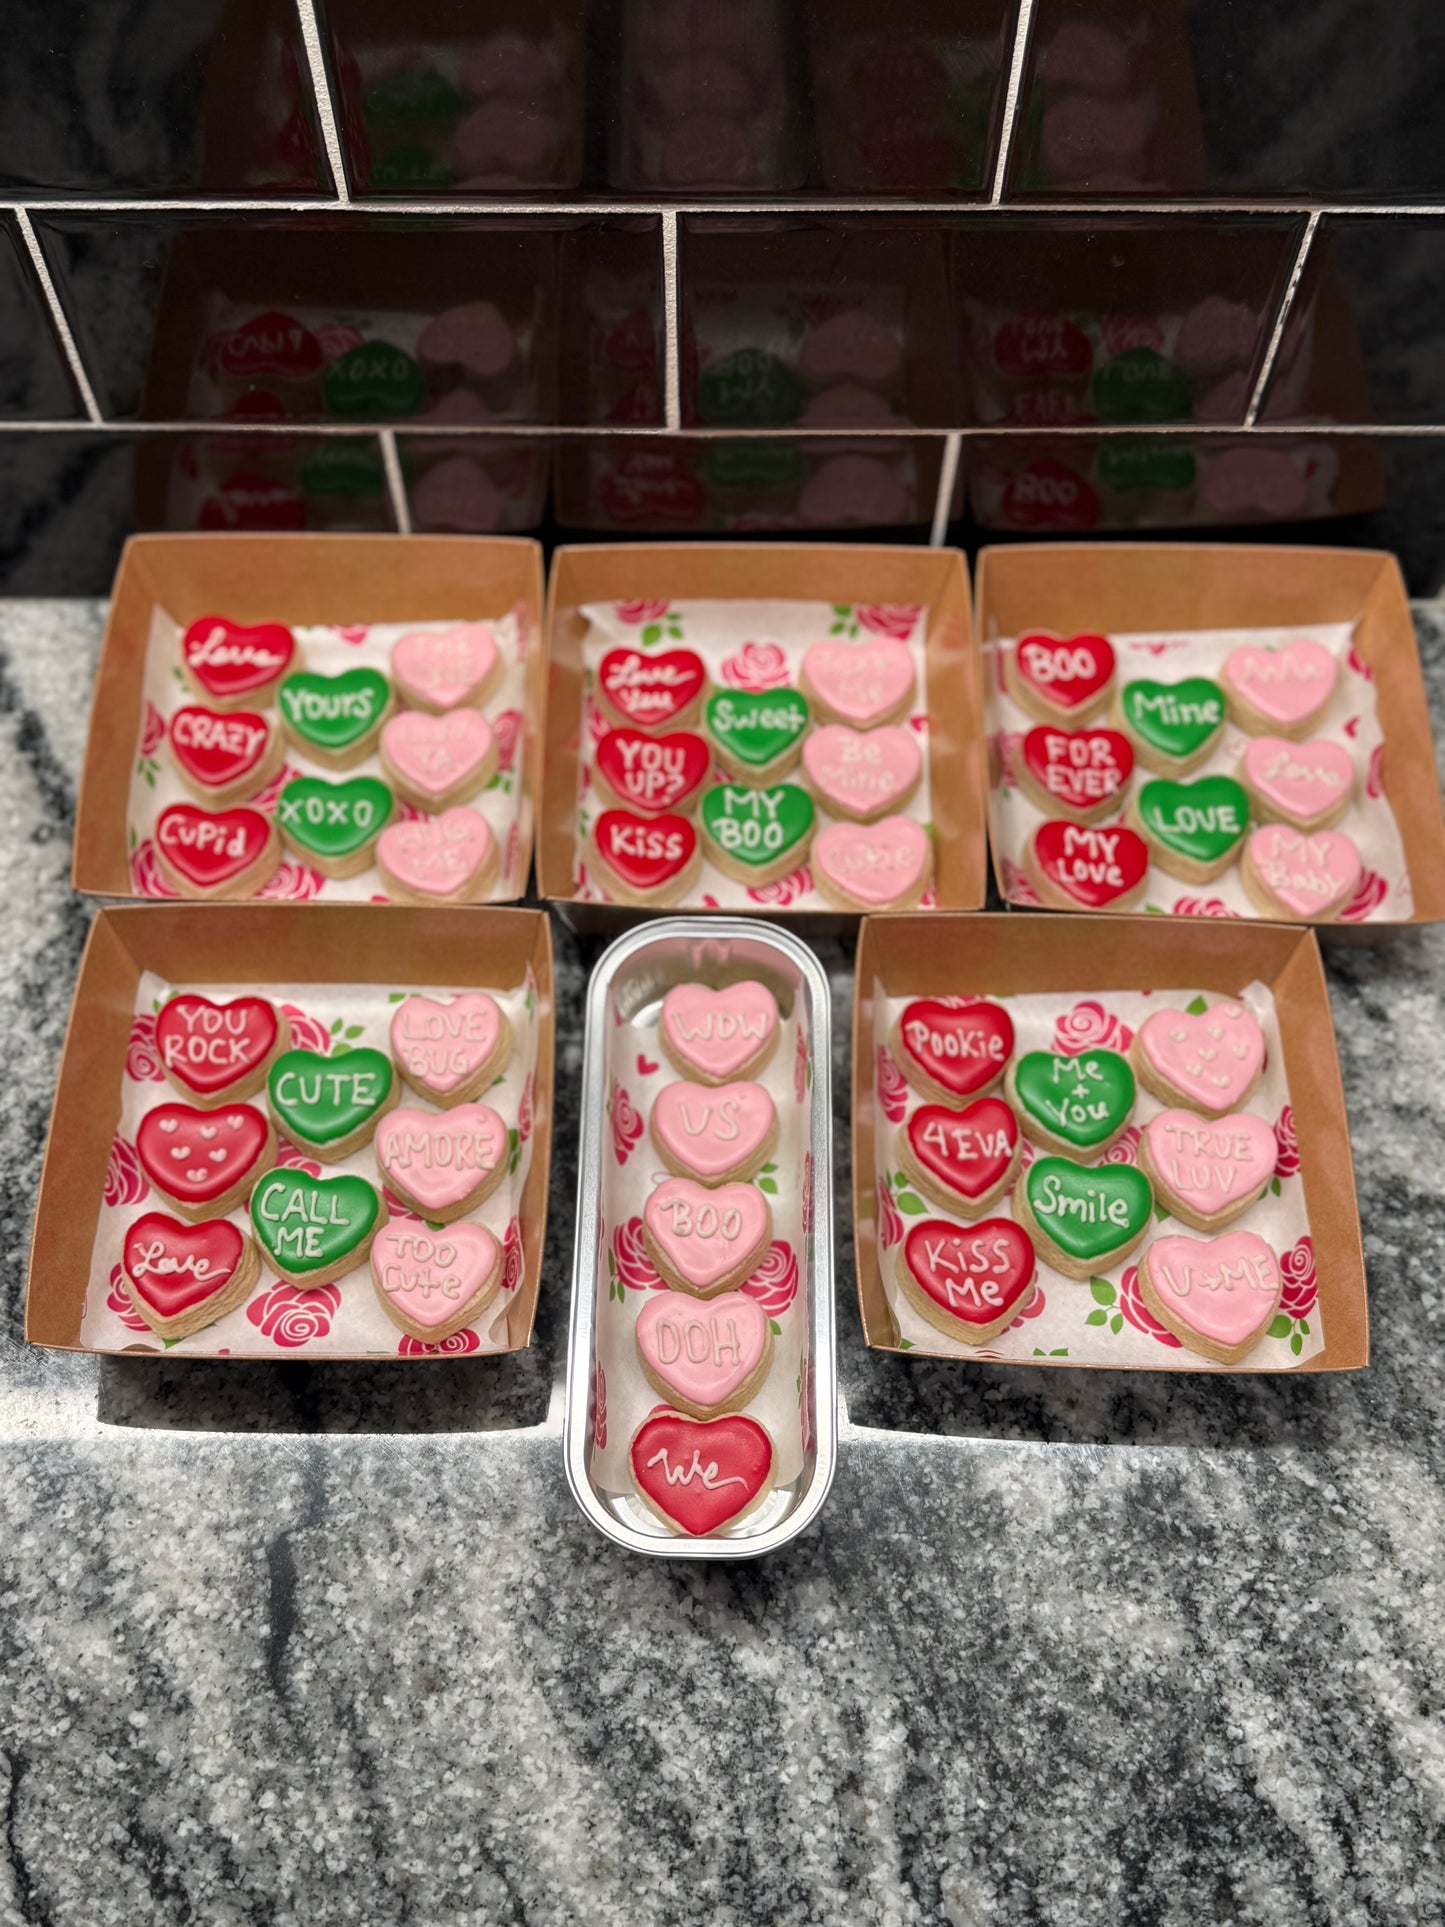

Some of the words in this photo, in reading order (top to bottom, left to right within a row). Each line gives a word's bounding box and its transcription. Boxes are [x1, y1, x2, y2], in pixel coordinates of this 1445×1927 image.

[190, 627, 286, 667] Love
[1022, 643, 1096, 683] BOO
[605, 654, 697, 690] Love
[711, 698, 805, 734] Sweet
[1132, 691, 1221, 725] Mine
[172, 713, 267, 756] CRAZY
[837, 736, 883, 764] Be
[1044, 735, 1117, 768] FOR
[616, 737, 686, 770] YOU
[1262, 752, 1345, 788] Love
[625, 769, 685, 806] UP?
[822, 765, 896, 793] Mine
[1046, 766, 1120, 796] EVER
[724, 789, 786, 820] MY
[1151, 806, 1242, 835] LOVE
[711, 817, 784, 849] BOO
[1063, 826, 1120, 862] MY
[1271, 831, 1334, 864] MY
[176, 1004, 248, 1036] YOU
[401, 1009, 488, 1043] LOVE
[672, 1011, 770, 1042] WOW
[164, 1033, 252, 1068] ROCK
[403, 1045, 470, 1077] BUG
[1053, 1058, 1104, 1084] Me
[275, 1072, 378, 1107] CUTE
[680, 1098, 742, 1142] US
[1045, 1099, 1110, 1128] You
[383, 1133, 496, 1171] AMORE
[1164, 1123, 1255, 1163] TRUE
[1171, 1159, 1236, 1194] LUV
[260, 1183, 351, 1226] CALL
[660, 1197, 744, 1241] BOO
[1034, 1175, 1131, 1230] Smile
[274, 1227, 325, 1260] ME
[385, 1235, 458, 1268] TOO
[131, 1241, 232, 1282] Love
[1162, 1264, 1191, 1297] U
[1220, 1255, 1279, 1291] ME
[381, 1263, 463, 1301] Cute
[945, 1278, 1005, 1308] Me
[656, 1319, 743, 1368] DOH
